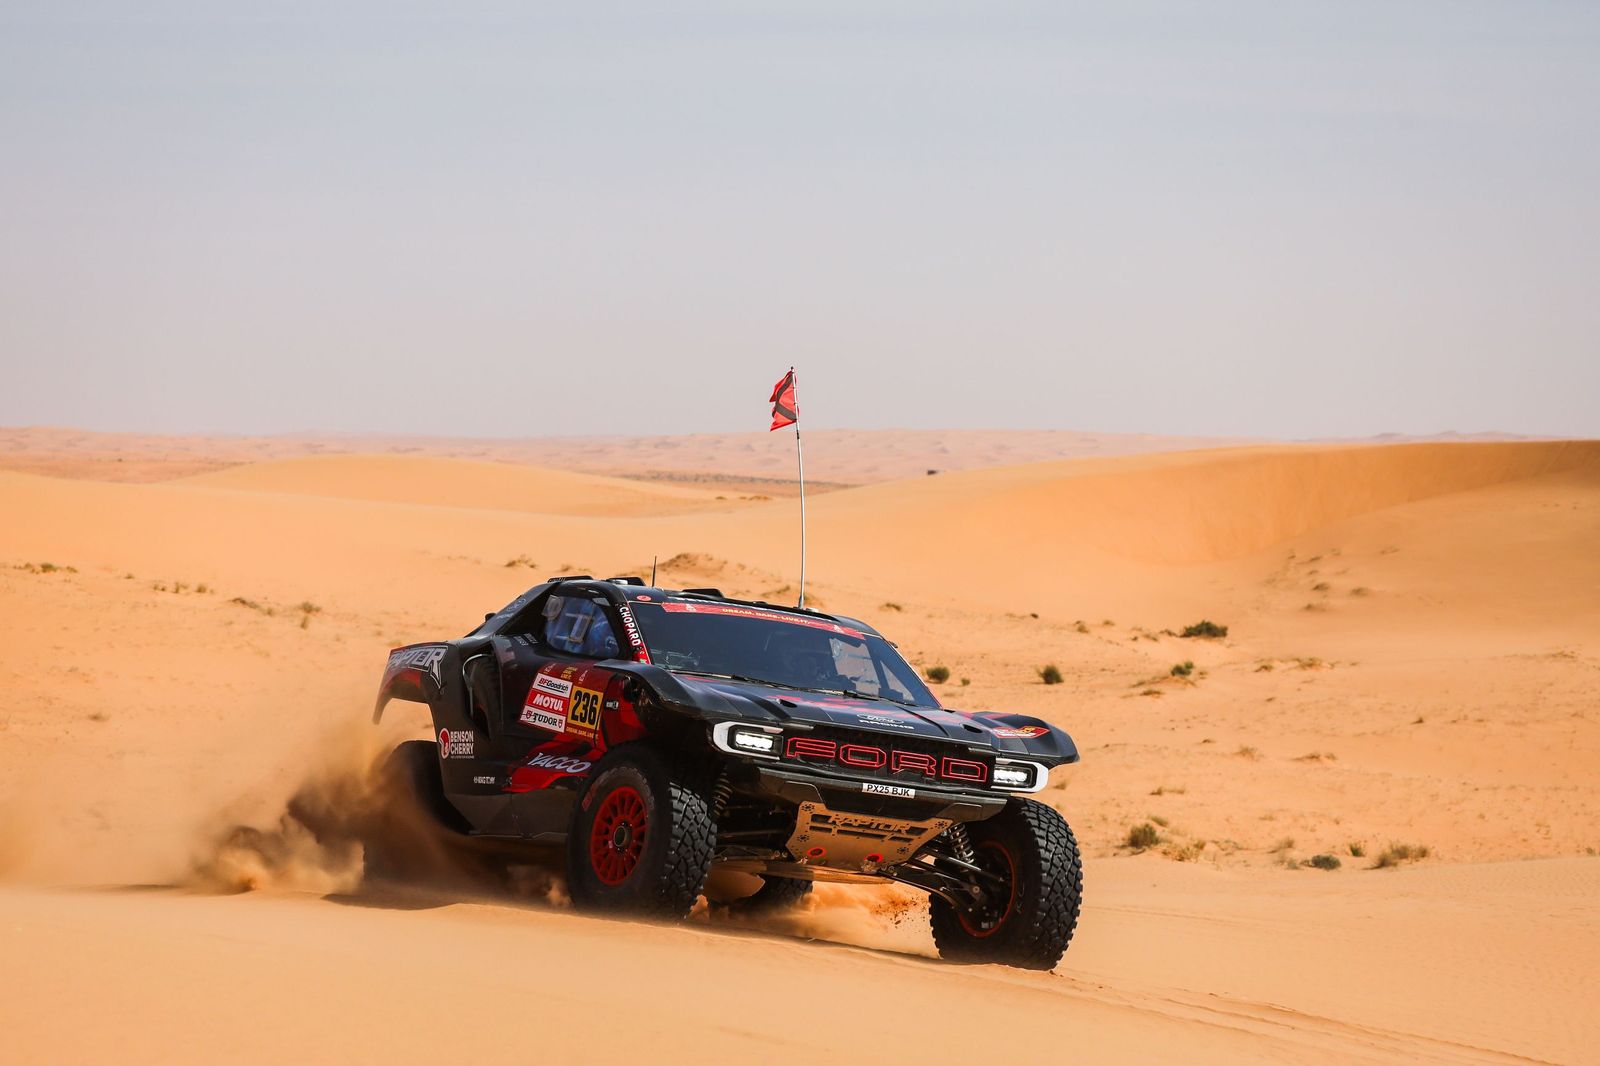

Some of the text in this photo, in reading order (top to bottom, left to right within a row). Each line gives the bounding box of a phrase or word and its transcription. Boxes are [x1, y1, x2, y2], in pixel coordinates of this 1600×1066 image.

[619, 606, 642, 646] CHOPARD
[539, 677, 569, 691] BFGoodrich
[532, 693, 564, 712] MOTUL
[570, 689, 599, 726] 236
[533, 712, 558, 727] TUDOR
[450, 730, 474, 743] BENSON
[450, 742, 474, 755] CHERRY
[527, 752, 592, 773] YACCO
[786, 737, 988, 783] FORD
[866, 784, 910, 797] PX25 BJK
